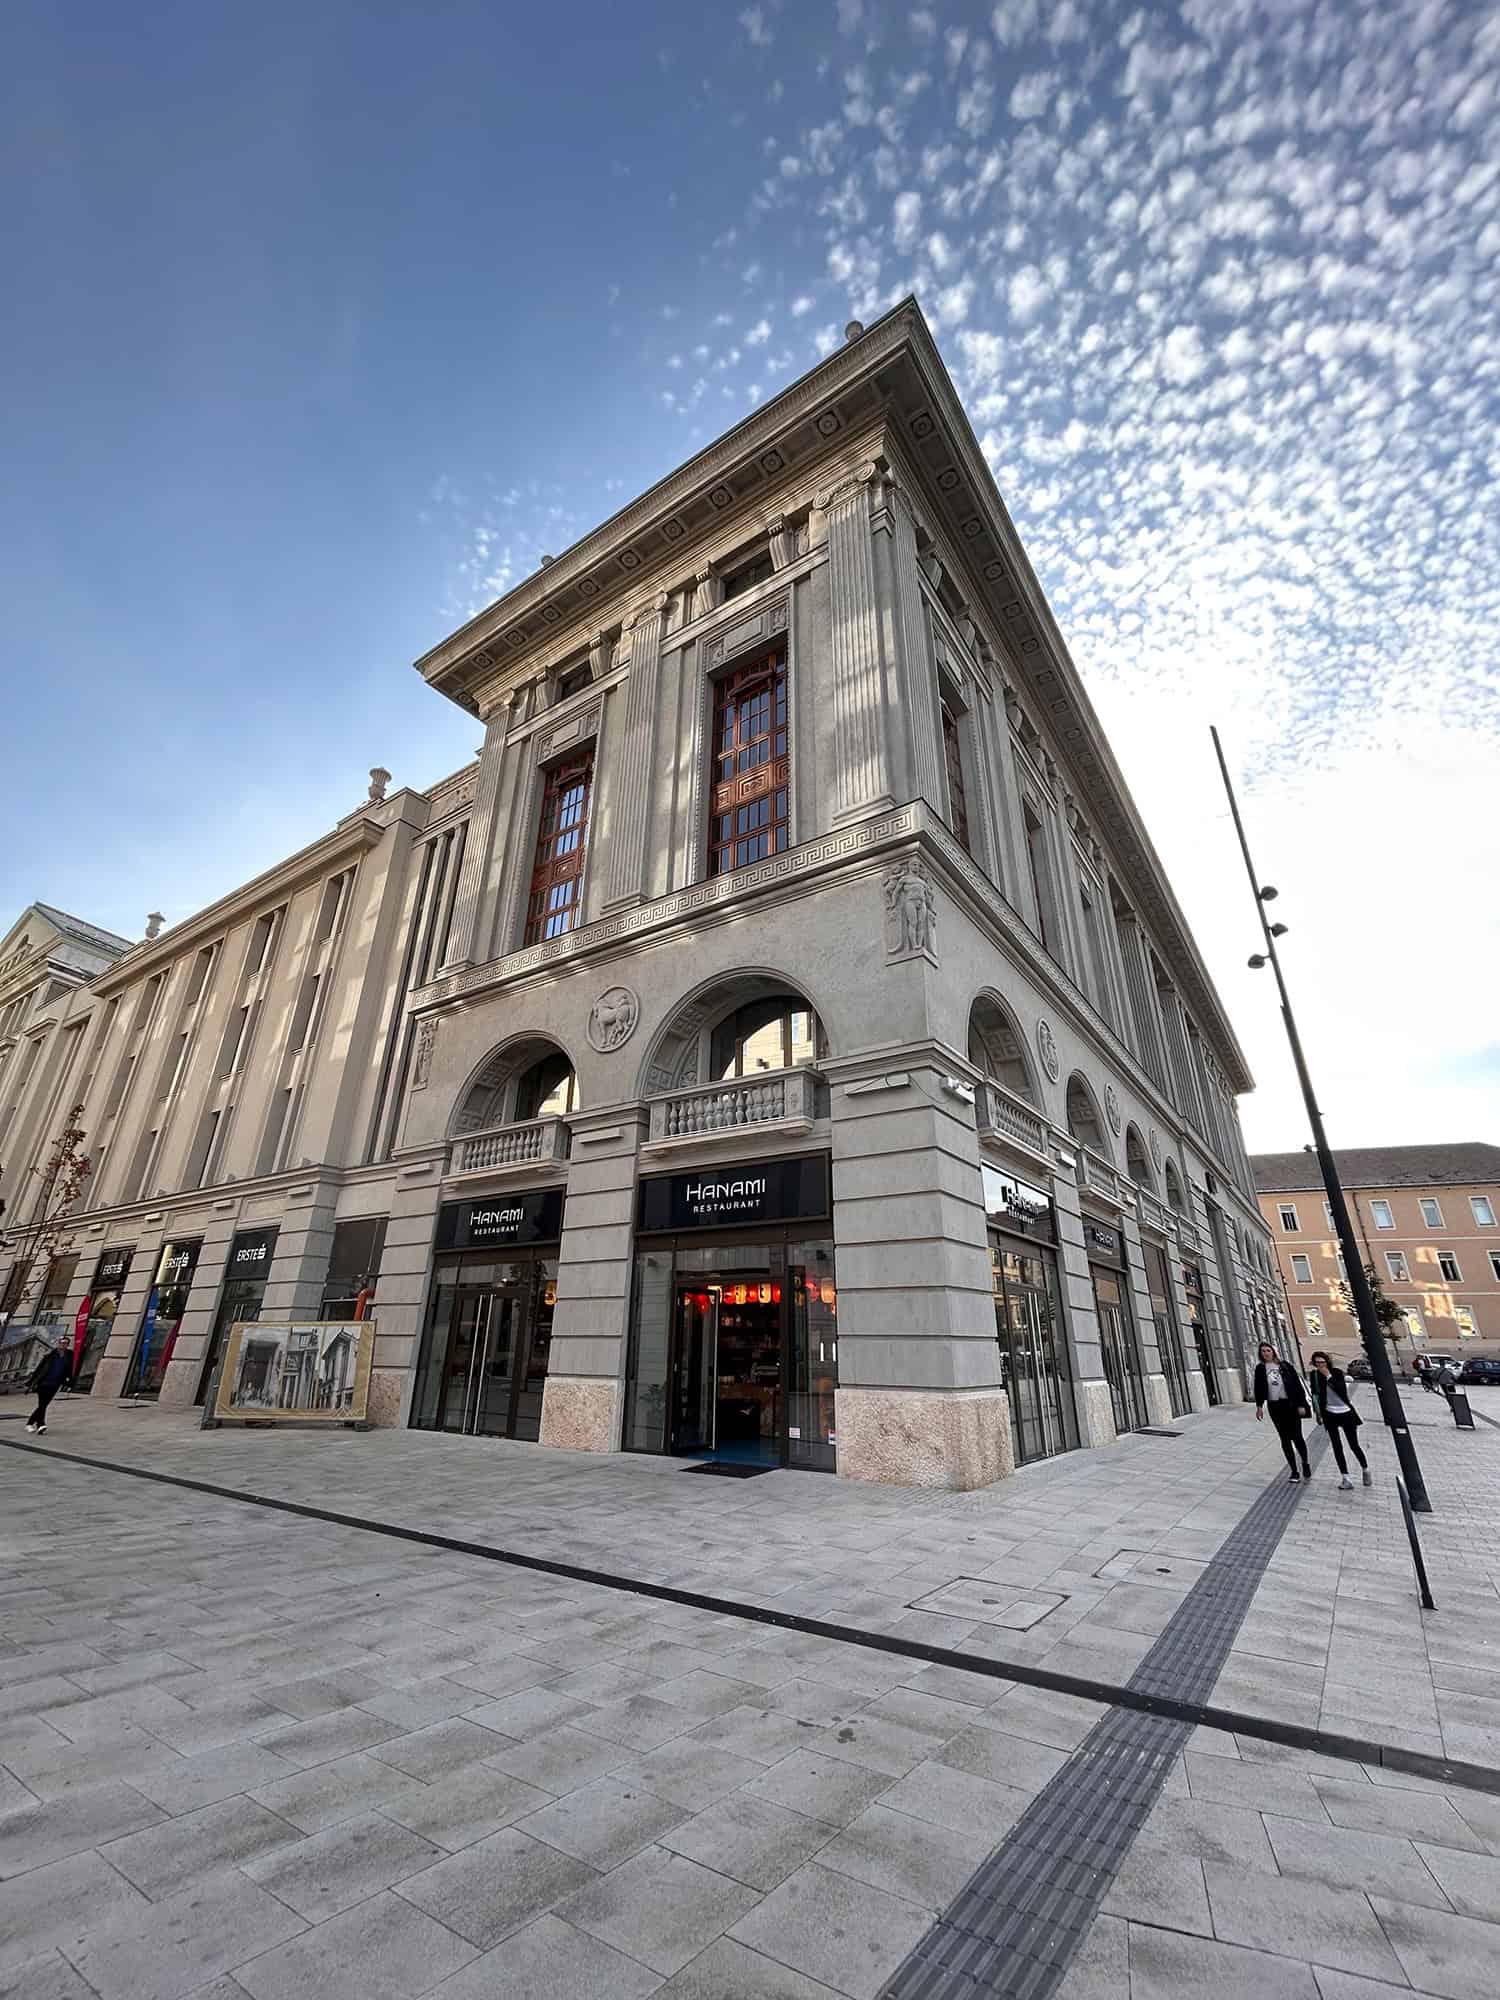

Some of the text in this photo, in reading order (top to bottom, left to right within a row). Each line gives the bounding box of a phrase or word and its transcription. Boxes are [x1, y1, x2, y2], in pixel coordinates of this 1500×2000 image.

[686, 1178, 765, 1201] HANAMI
[693, 1199, 760, 1213] RESTAURANT
[470, 1208, 523, 1226] HANAMI
